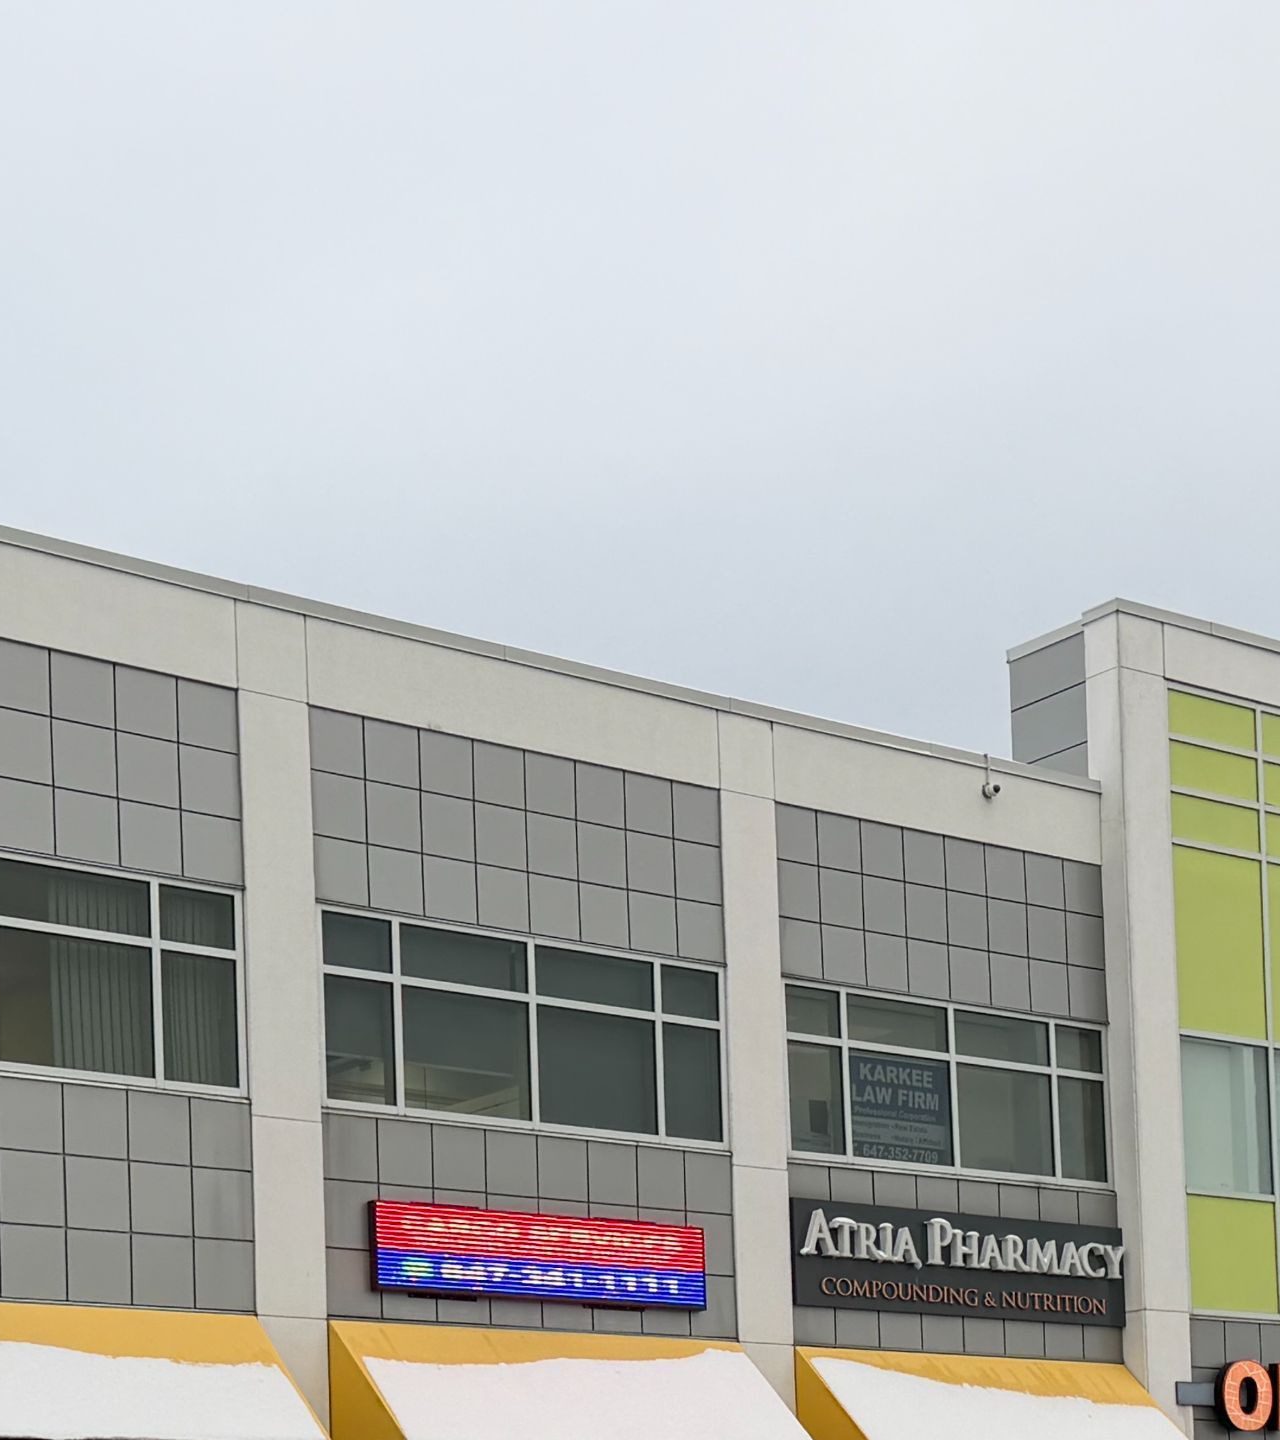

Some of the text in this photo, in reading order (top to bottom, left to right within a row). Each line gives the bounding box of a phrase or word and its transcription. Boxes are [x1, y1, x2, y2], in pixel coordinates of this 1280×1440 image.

[859, 1062, 934, 1089] KARKEE
[851, 1083, 940, 1112] LAW FIRM
[799, 1207, 1126, 1280] ATRIA PHARMACY
[821, 1276, 1107, 1316] COMPOUNDING & NUTRITION
